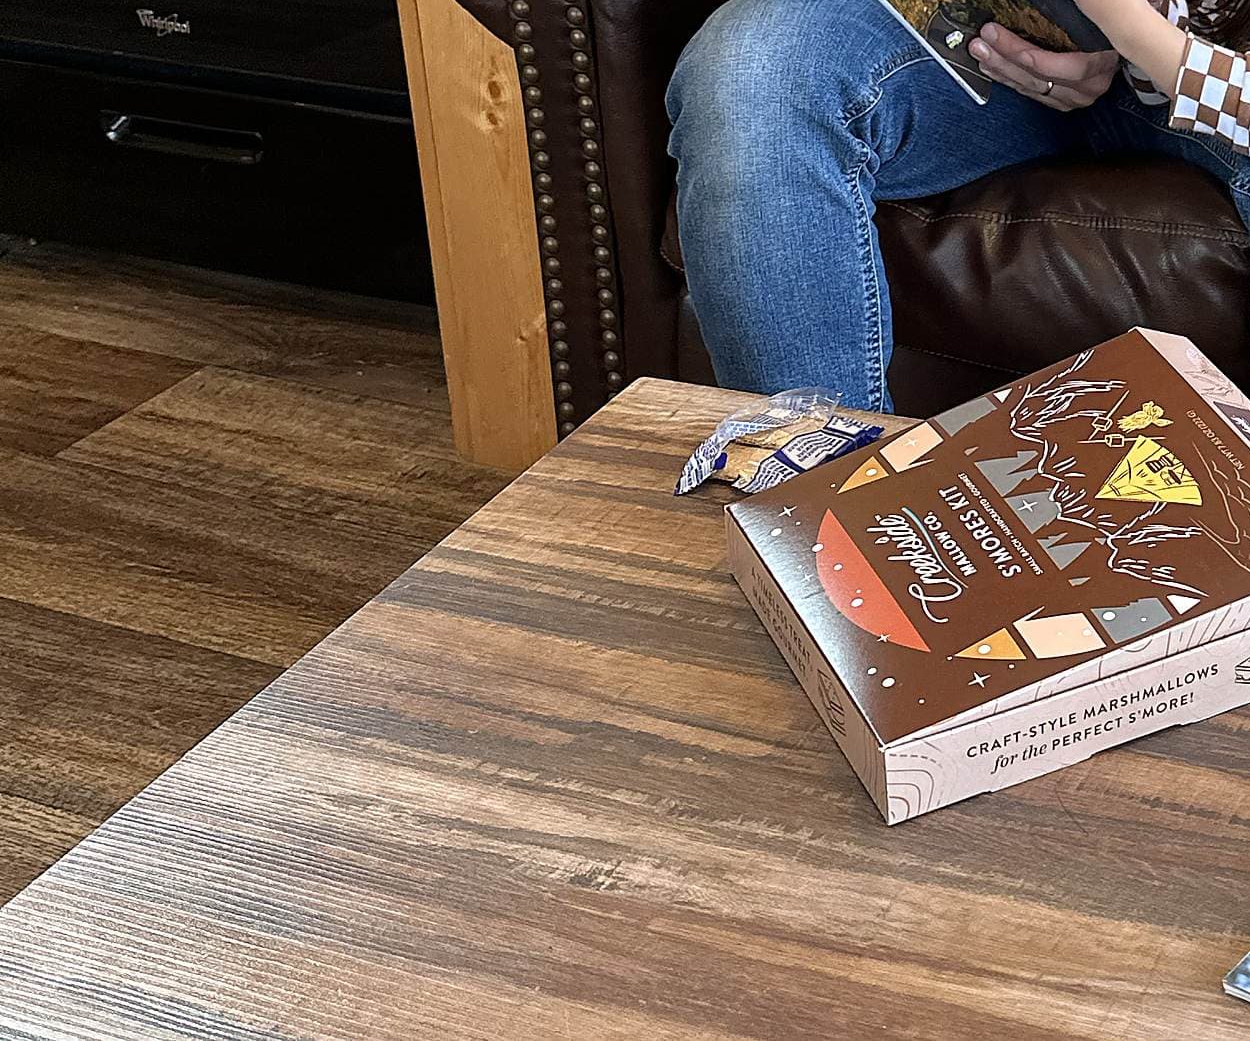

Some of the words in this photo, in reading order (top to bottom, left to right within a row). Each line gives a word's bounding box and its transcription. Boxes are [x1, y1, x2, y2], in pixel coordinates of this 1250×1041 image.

[939, 486, 970, 510] KIT
[957, 473, 980, 496] GOURMET
[924, 512, 942, 530] CO.
[980, 498, 1012, 536] HANDCRAFTED
[934, 531, 977, 576] MALLOW
[960, 510, 1021, 577] S'MORES
[1011, 538, 1029, 557] BATCH
[866, 514, 963, 623] Creekside
[1026, 556, 1043, 575] SMALL
[967, 713, 1077, 758] CRAFT-STYLE
[1083, 664, 1219, 721] MARSHMALLOWS
[991, 754, 1019, 774] for
[1022, 740, 1047, 760] the
[1052, 716, 1123, 751] PERFECT
[1128, 692, 1195, 724] S'MORE!
